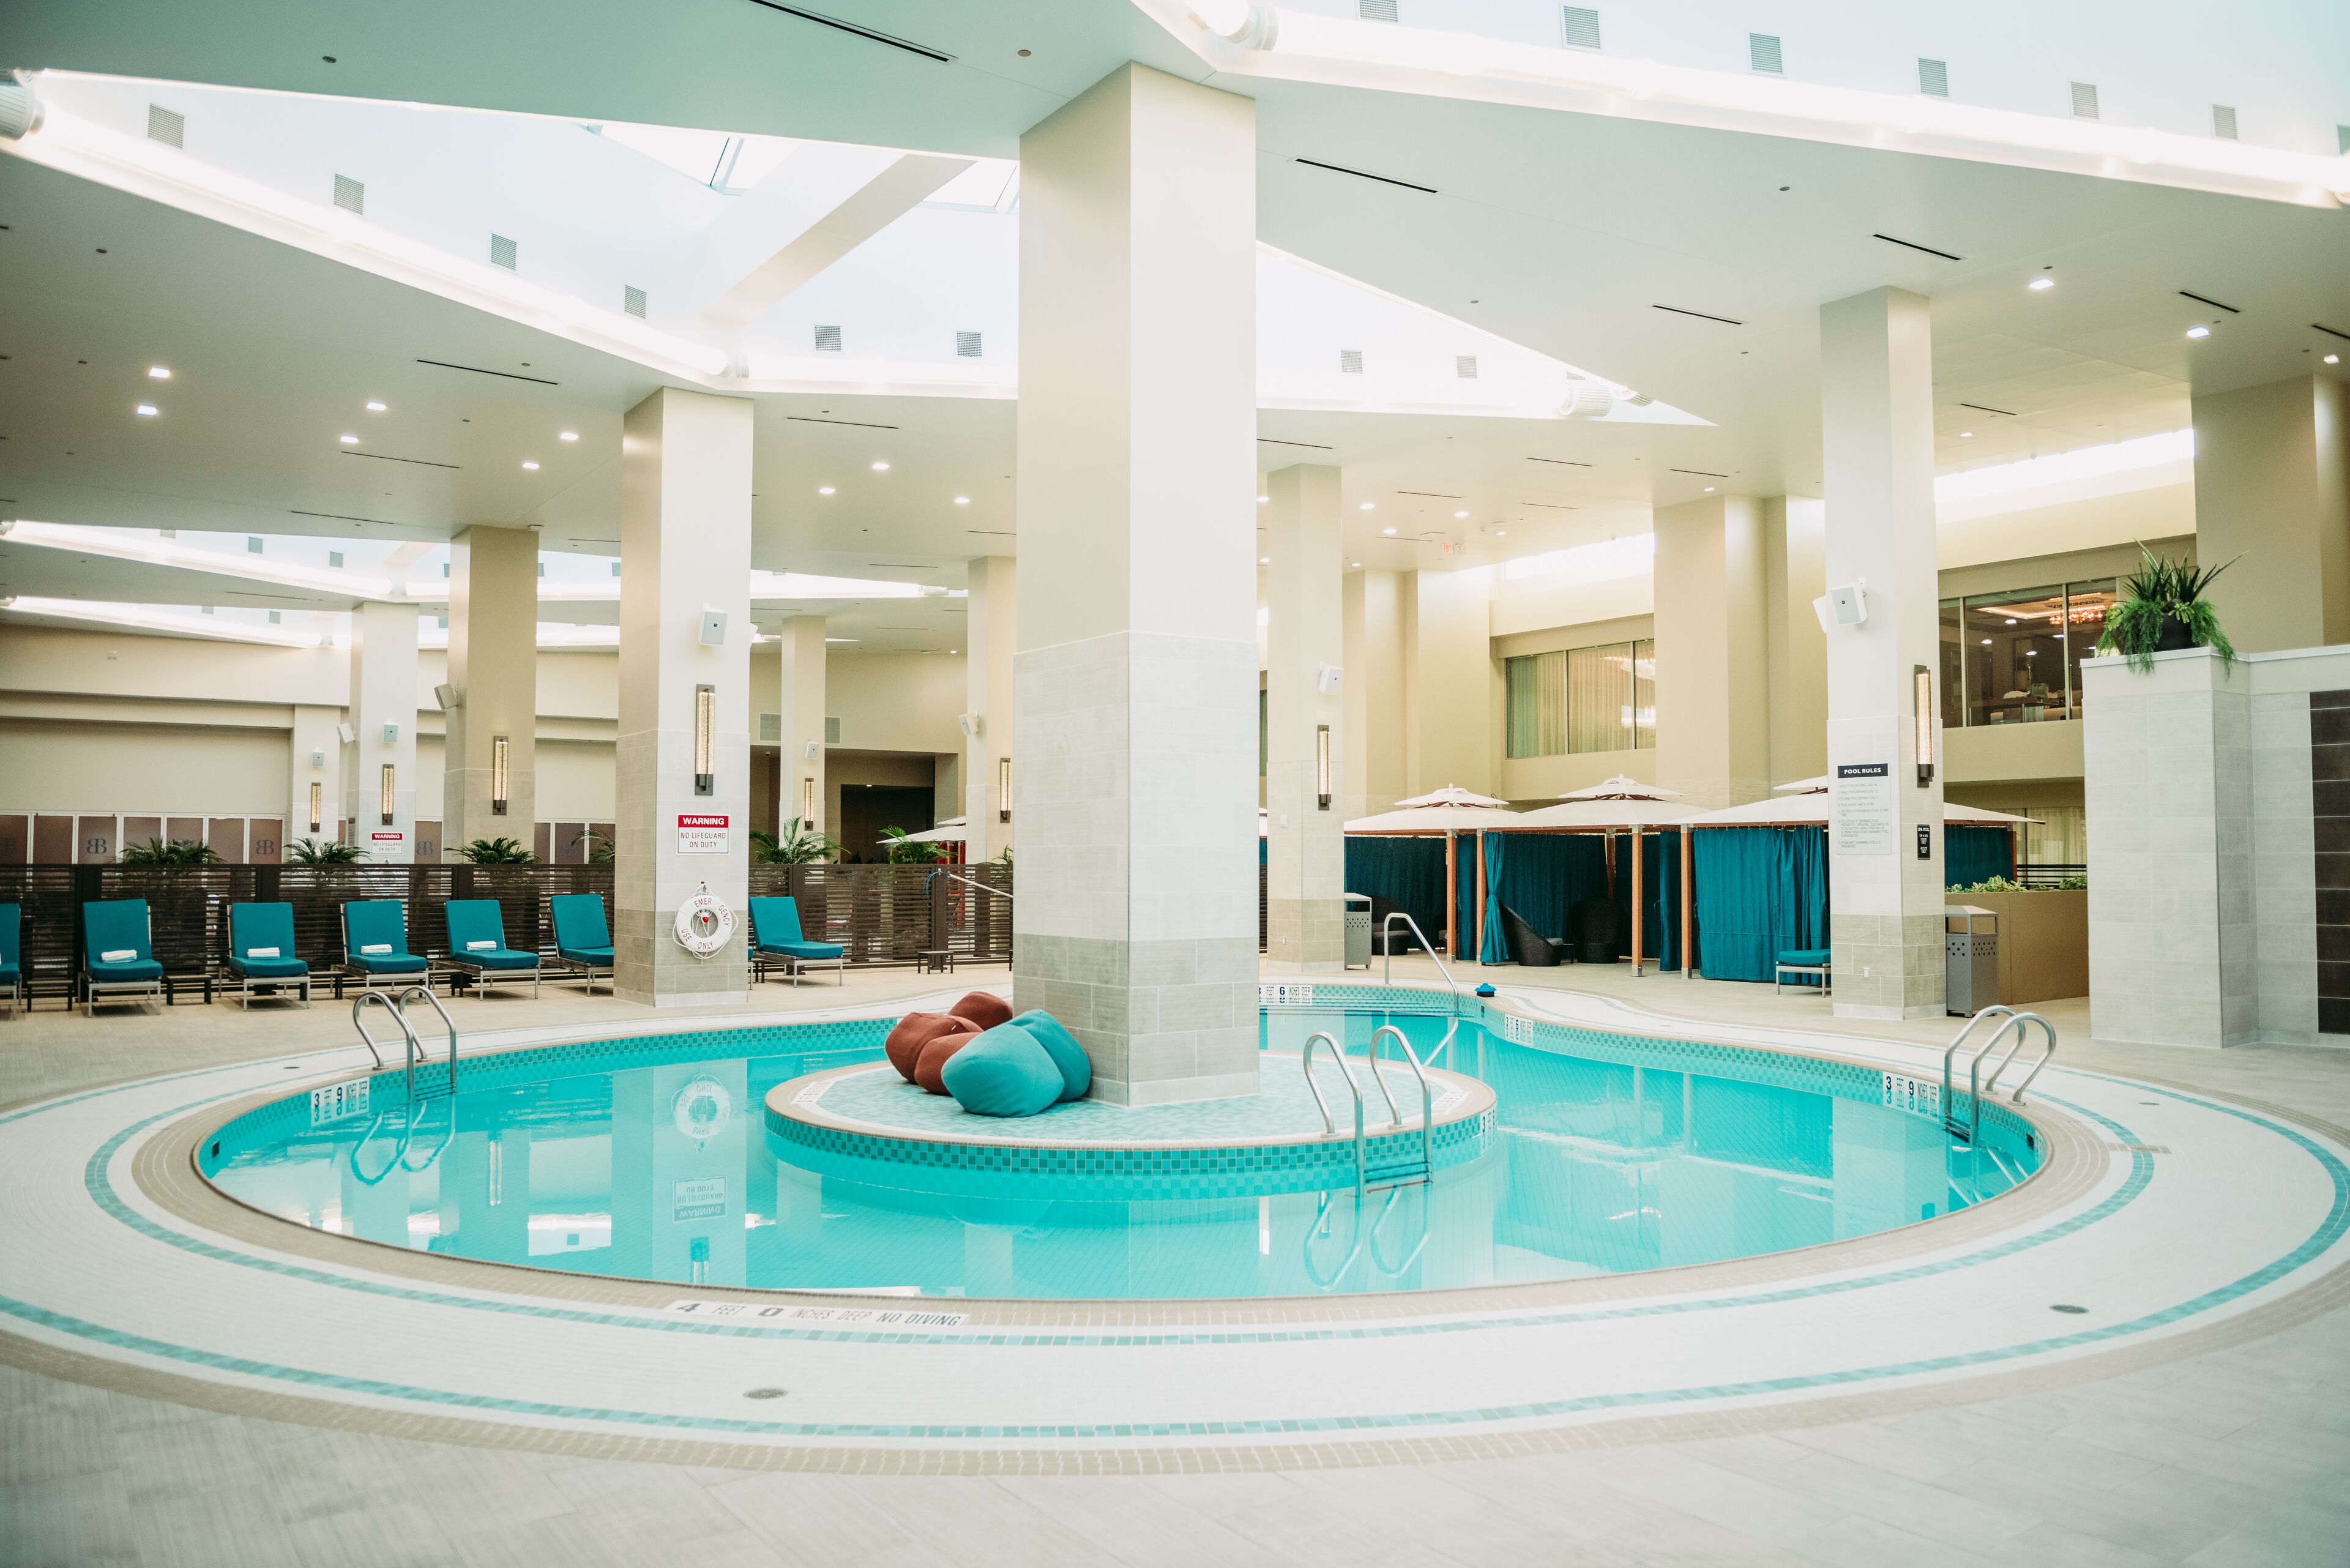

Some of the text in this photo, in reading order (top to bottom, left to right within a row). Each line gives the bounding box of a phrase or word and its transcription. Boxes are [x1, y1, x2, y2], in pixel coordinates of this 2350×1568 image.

[681, 928, 714, 949] USE ONLY
[1280, 987, 1285, 995] 6
[1886, 1076, 1892, 1090] 3
[1909, 1081, 1914, 1096] 9
[315, 1093, 319, 1108] 3
[337, 1087, 342, 1102] 9
[676, 1303, 961, 1326] 4 FEET 0 INCHES DEEP NO DIVING
